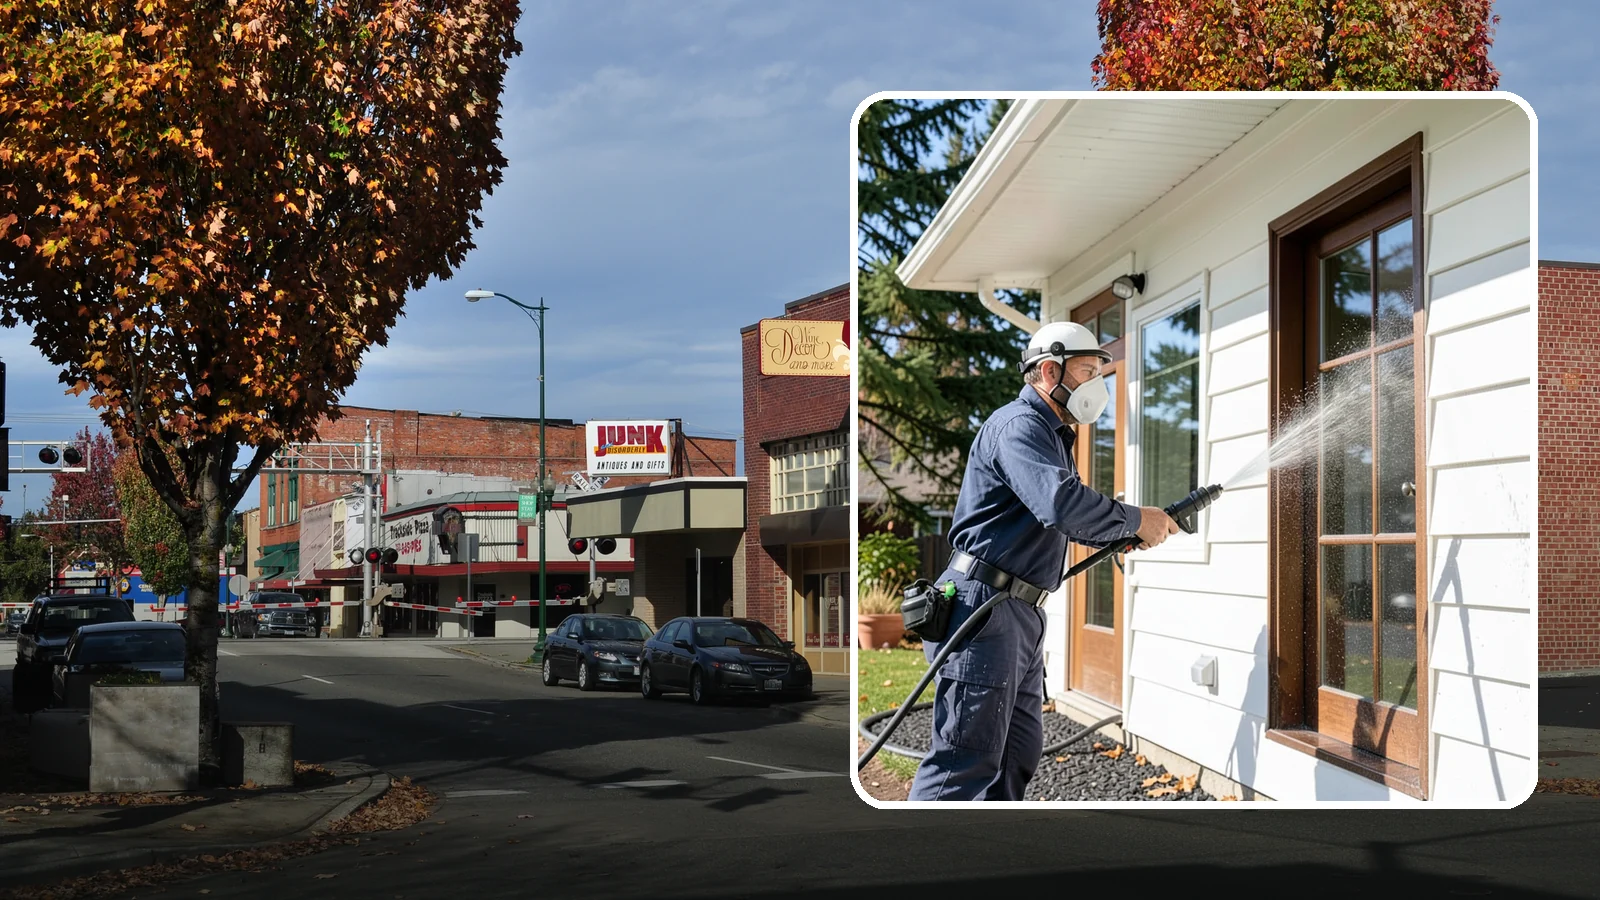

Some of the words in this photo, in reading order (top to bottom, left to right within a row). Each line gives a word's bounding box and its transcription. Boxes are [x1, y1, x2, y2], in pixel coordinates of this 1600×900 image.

[764, 327, 831, 365] Decor
[596, 425, 665, 457] JUNK
[607, 446, 646, 454] DISORDERLY
[597, 461, 628, 470] ANTIQUES
[631, 461, 644, 470] AND
[647, 460, 666, 469] GIFTS
[573, 473, 589, 492] RAIL
[414, 519, 429, 535] Pizza
